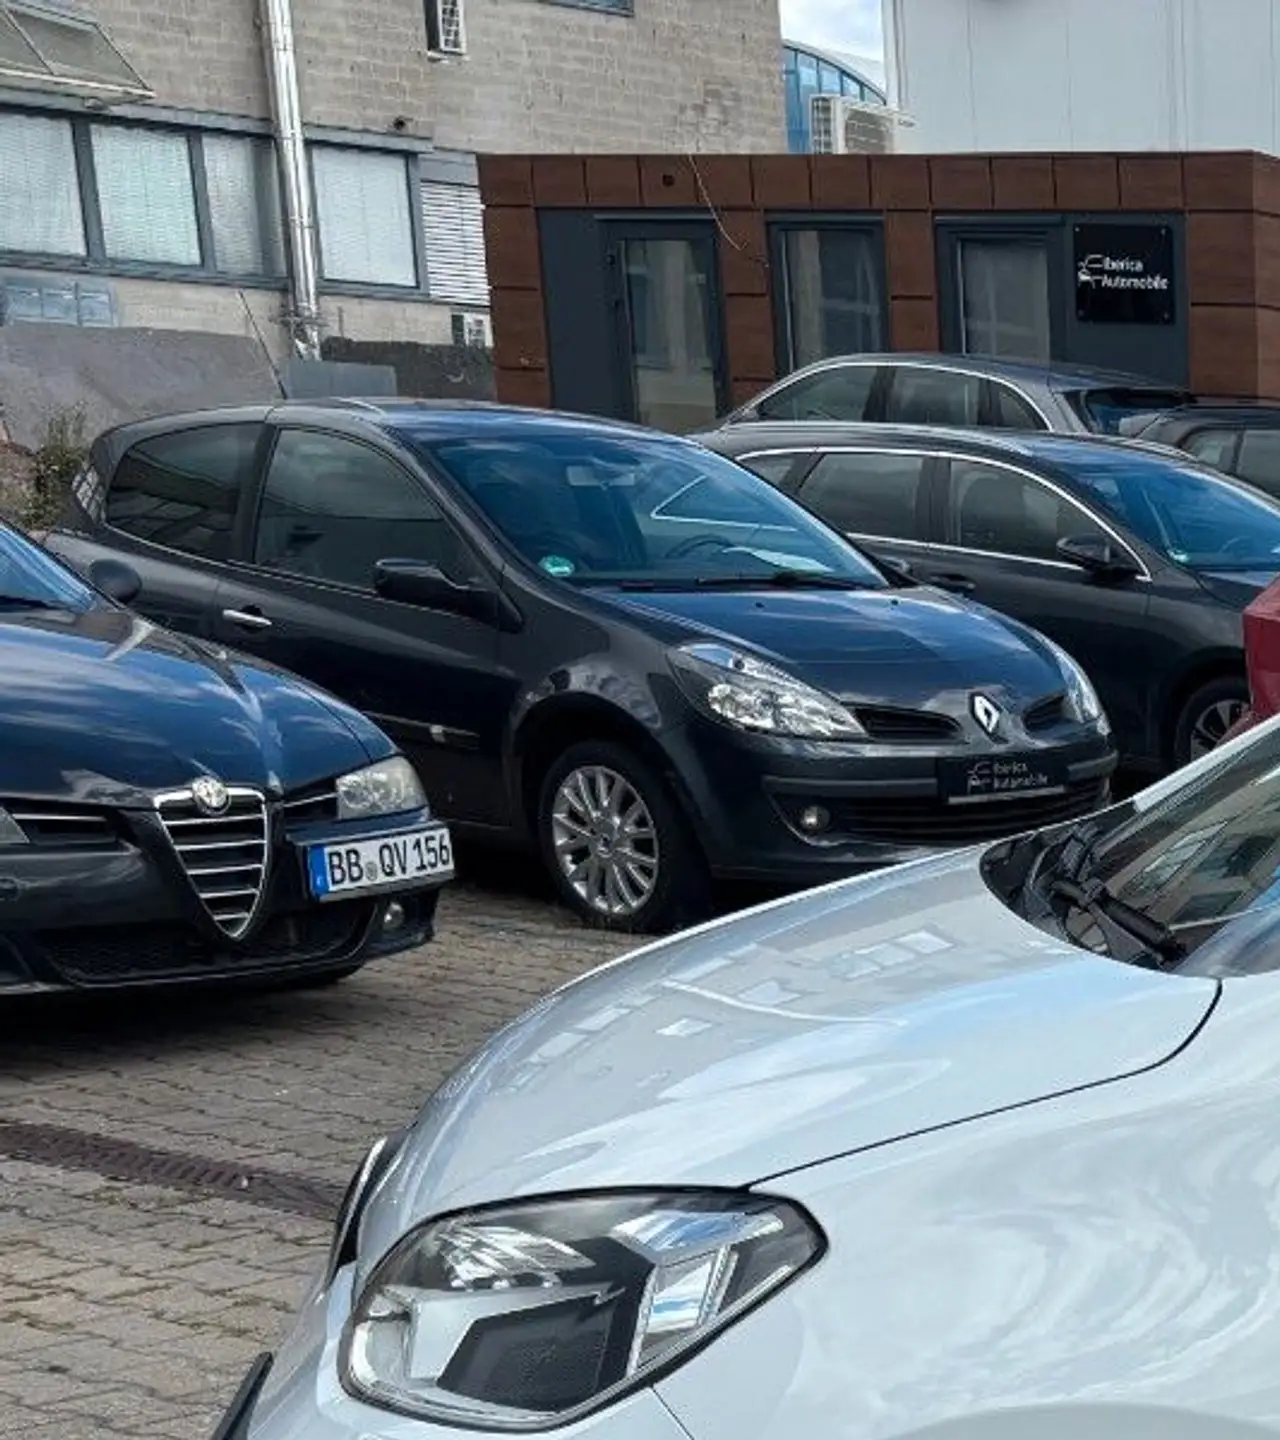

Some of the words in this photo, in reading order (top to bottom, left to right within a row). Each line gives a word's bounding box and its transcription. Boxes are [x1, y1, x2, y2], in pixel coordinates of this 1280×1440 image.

[328, 848, 364, 885] BB
[379, 839, 408, 877] QV
[412, 833, 450, 872] 156
